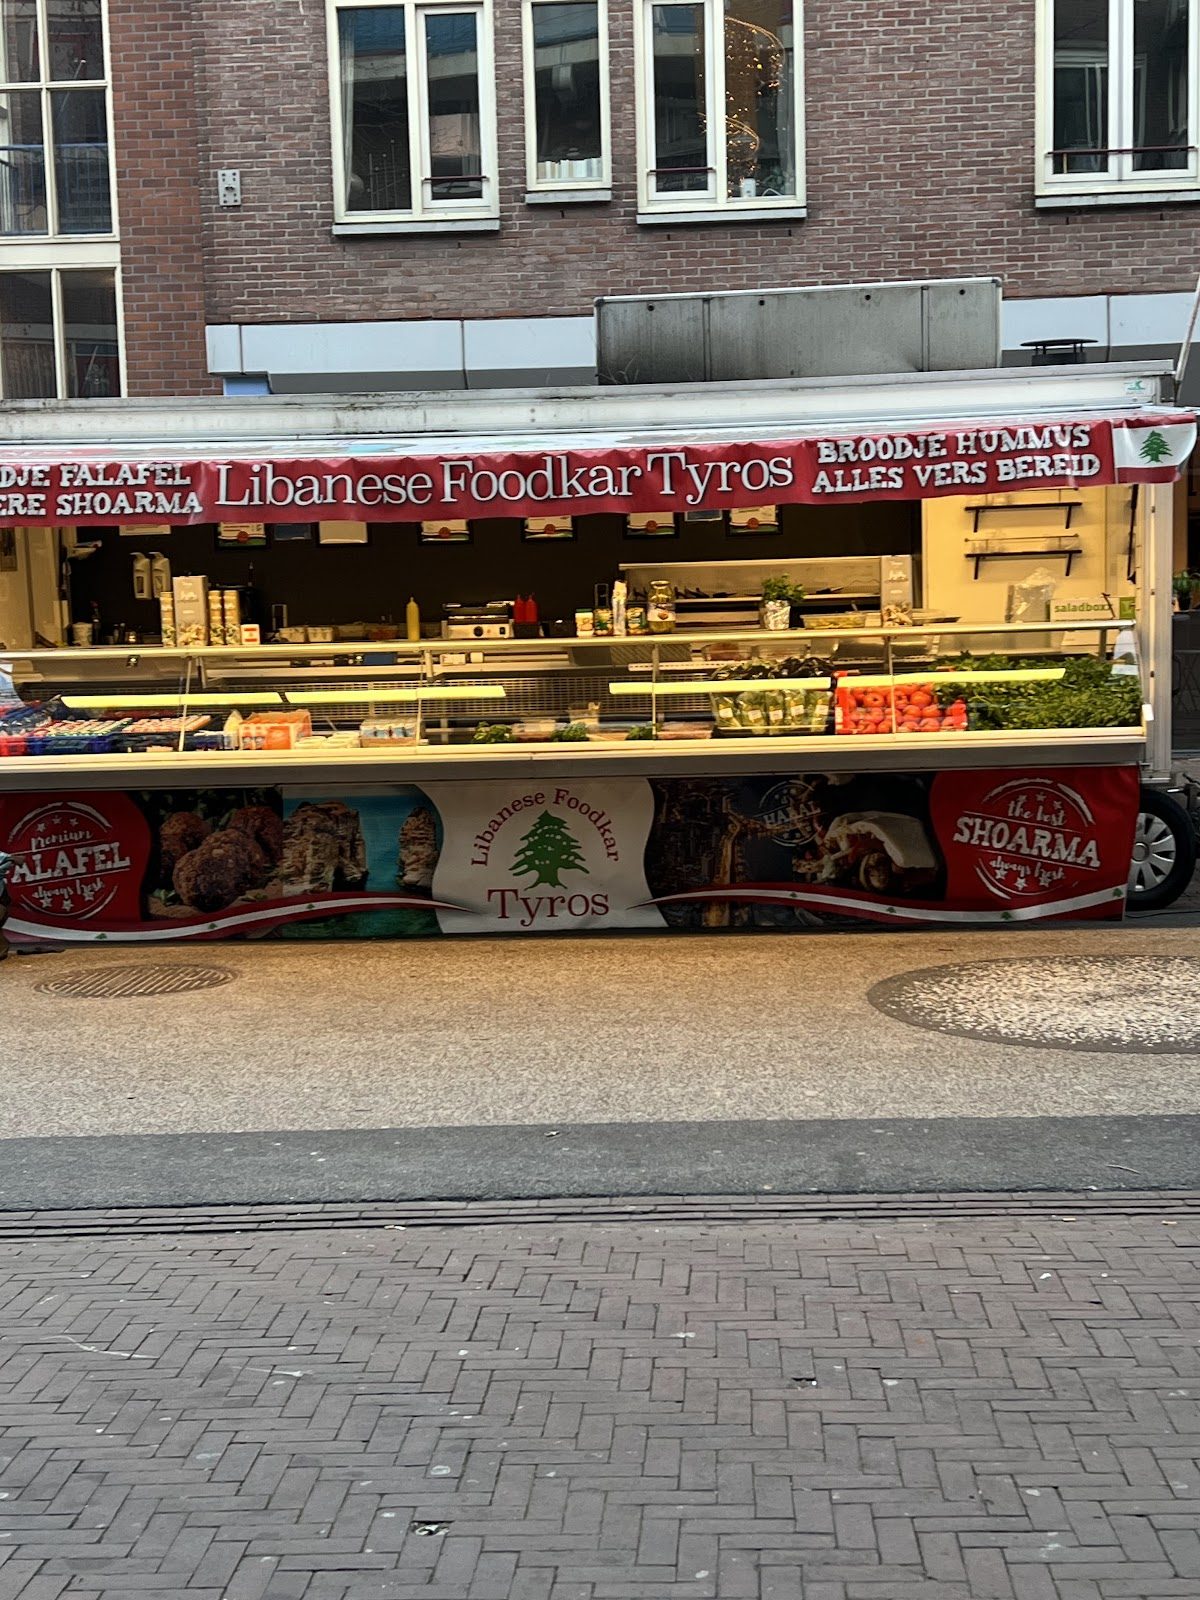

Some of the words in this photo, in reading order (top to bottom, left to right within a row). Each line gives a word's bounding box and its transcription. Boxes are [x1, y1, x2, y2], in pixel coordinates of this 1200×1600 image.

[817, 434, 947, 464] BROODJE
[957, 425, 1091, 455] HUMMUS
[60, 463, 191, 487] FALAFEL
[215, 464, 433, 505] Libanese
[441, 455, 642, 503] Foodkar
[647, 452, 794, 505] Tyros
[812, 466, 904, 494] ALLES
[912, 461, 987, 487] VERS
[997, 453, 1101, 482] BEREID
[56, 492, 203, 516] SHOARMA
[471, 792, 546, 867] Libanese
[552, 788, 620, 862] Foodkar
[1008, 800, 1033, 819] the
[1037, 805, 1068, 826] best
[953, 816, 1101, 867] SHOARMA
[8, 842, 131, 883] ALAFEL
[487, 889, 610, 927] Tyros
